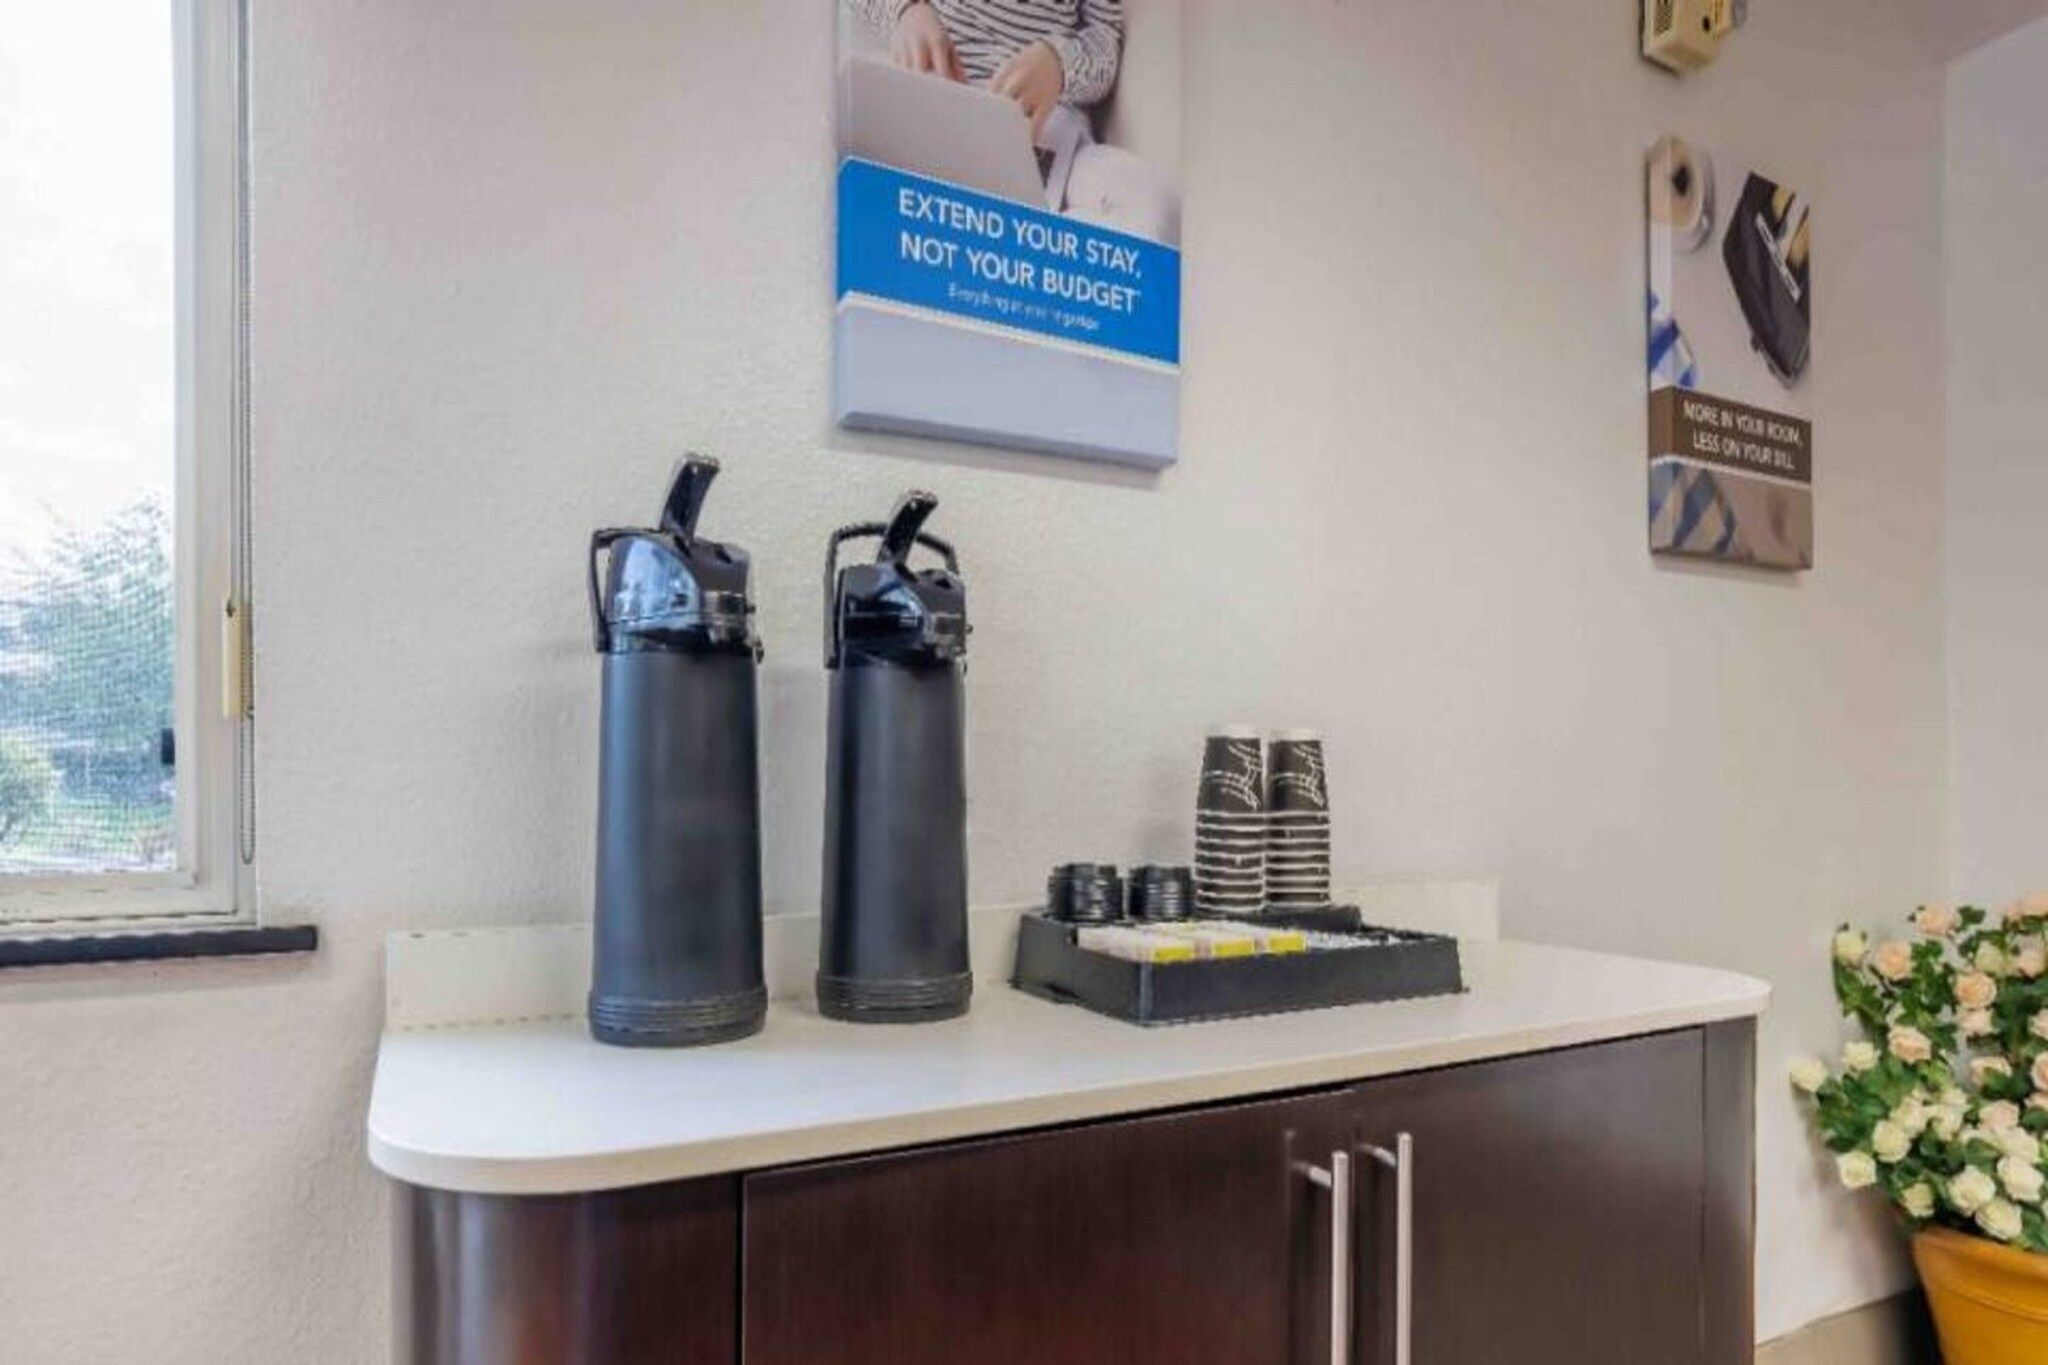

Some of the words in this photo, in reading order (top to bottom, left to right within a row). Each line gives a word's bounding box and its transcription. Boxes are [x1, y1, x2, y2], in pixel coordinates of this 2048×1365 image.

[898, 187, 1004, 239] EXTEND
[1013, 218, 1078, 259] YOUR
[1086, 239, 1142, 278] STAY,
[900, 232, 958, 268] NOT
[967, 249, 1035, 290] YOUR
[1042, 268, 1141, 313] BUDGET
[1683, 399, 1719, 426] MORE
[1721, 411, 1732, 428] IN
[1736, 414, 1764, 435] YOUR
[1693, 431, 1719, 452] LESS
[1723, 439, 1739, 457] ON
[1744, 443, 1772, 464] YOUR
